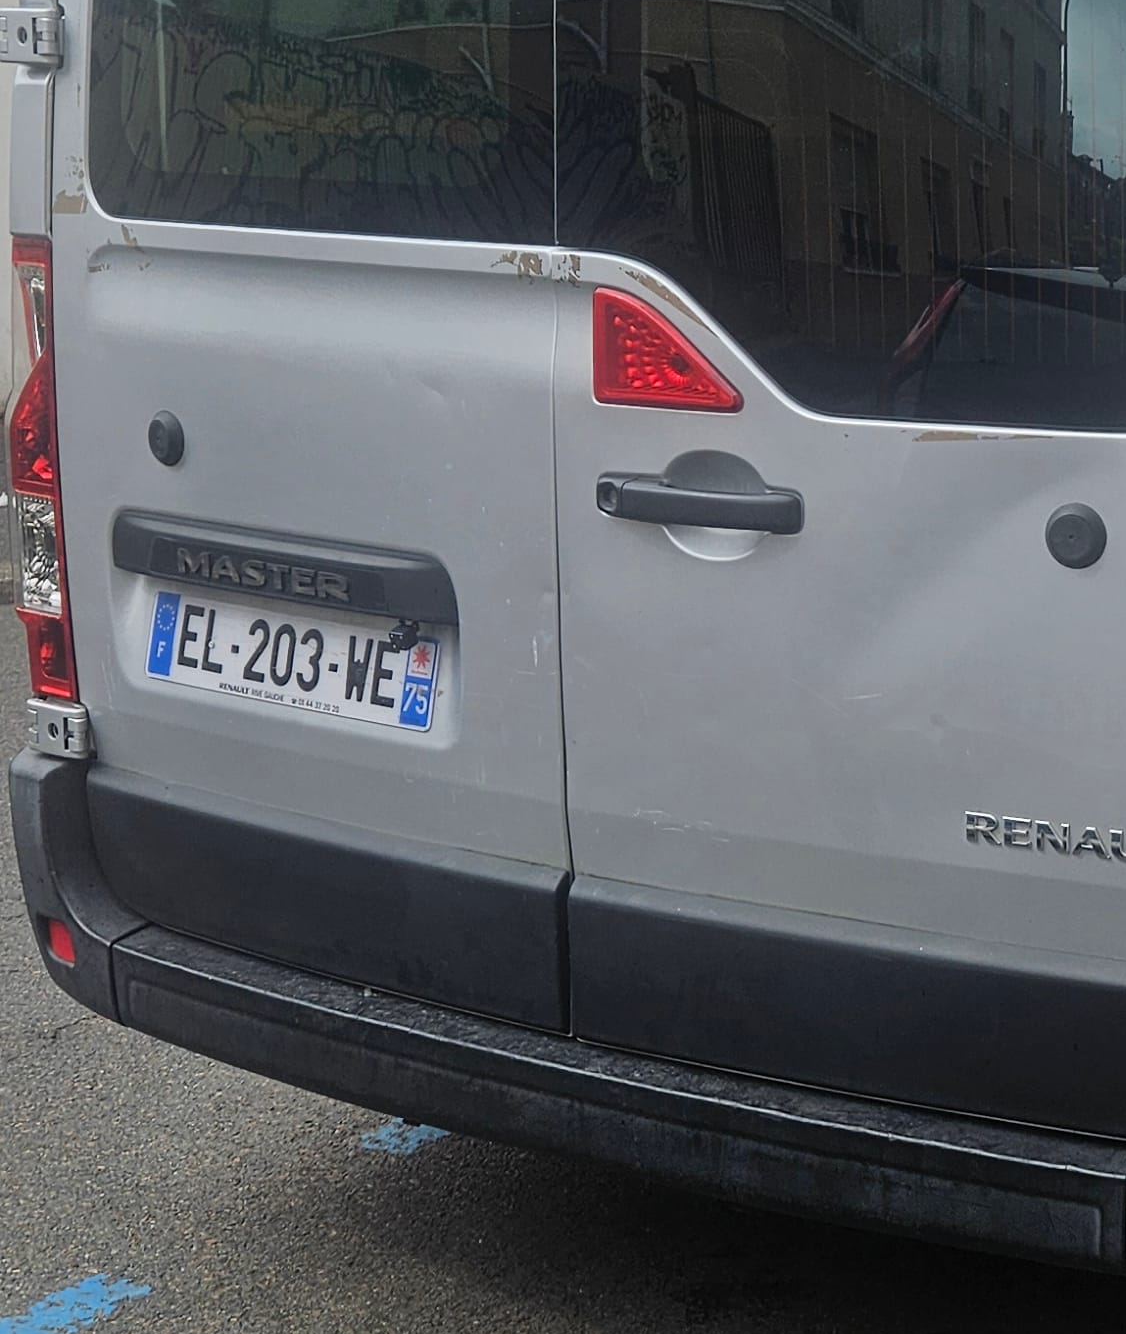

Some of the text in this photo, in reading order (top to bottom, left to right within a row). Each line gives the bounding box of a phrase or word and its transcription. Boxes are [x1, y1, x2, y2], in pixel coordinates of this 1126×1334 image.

[176, 547, 350, 602] MASTER
[156, 641, 167, 658] F
[177, 604, 400, 708] EL-203-WE
[219, 682, 250, 695] RENAULT
[402, 682, 429, 715] 75
